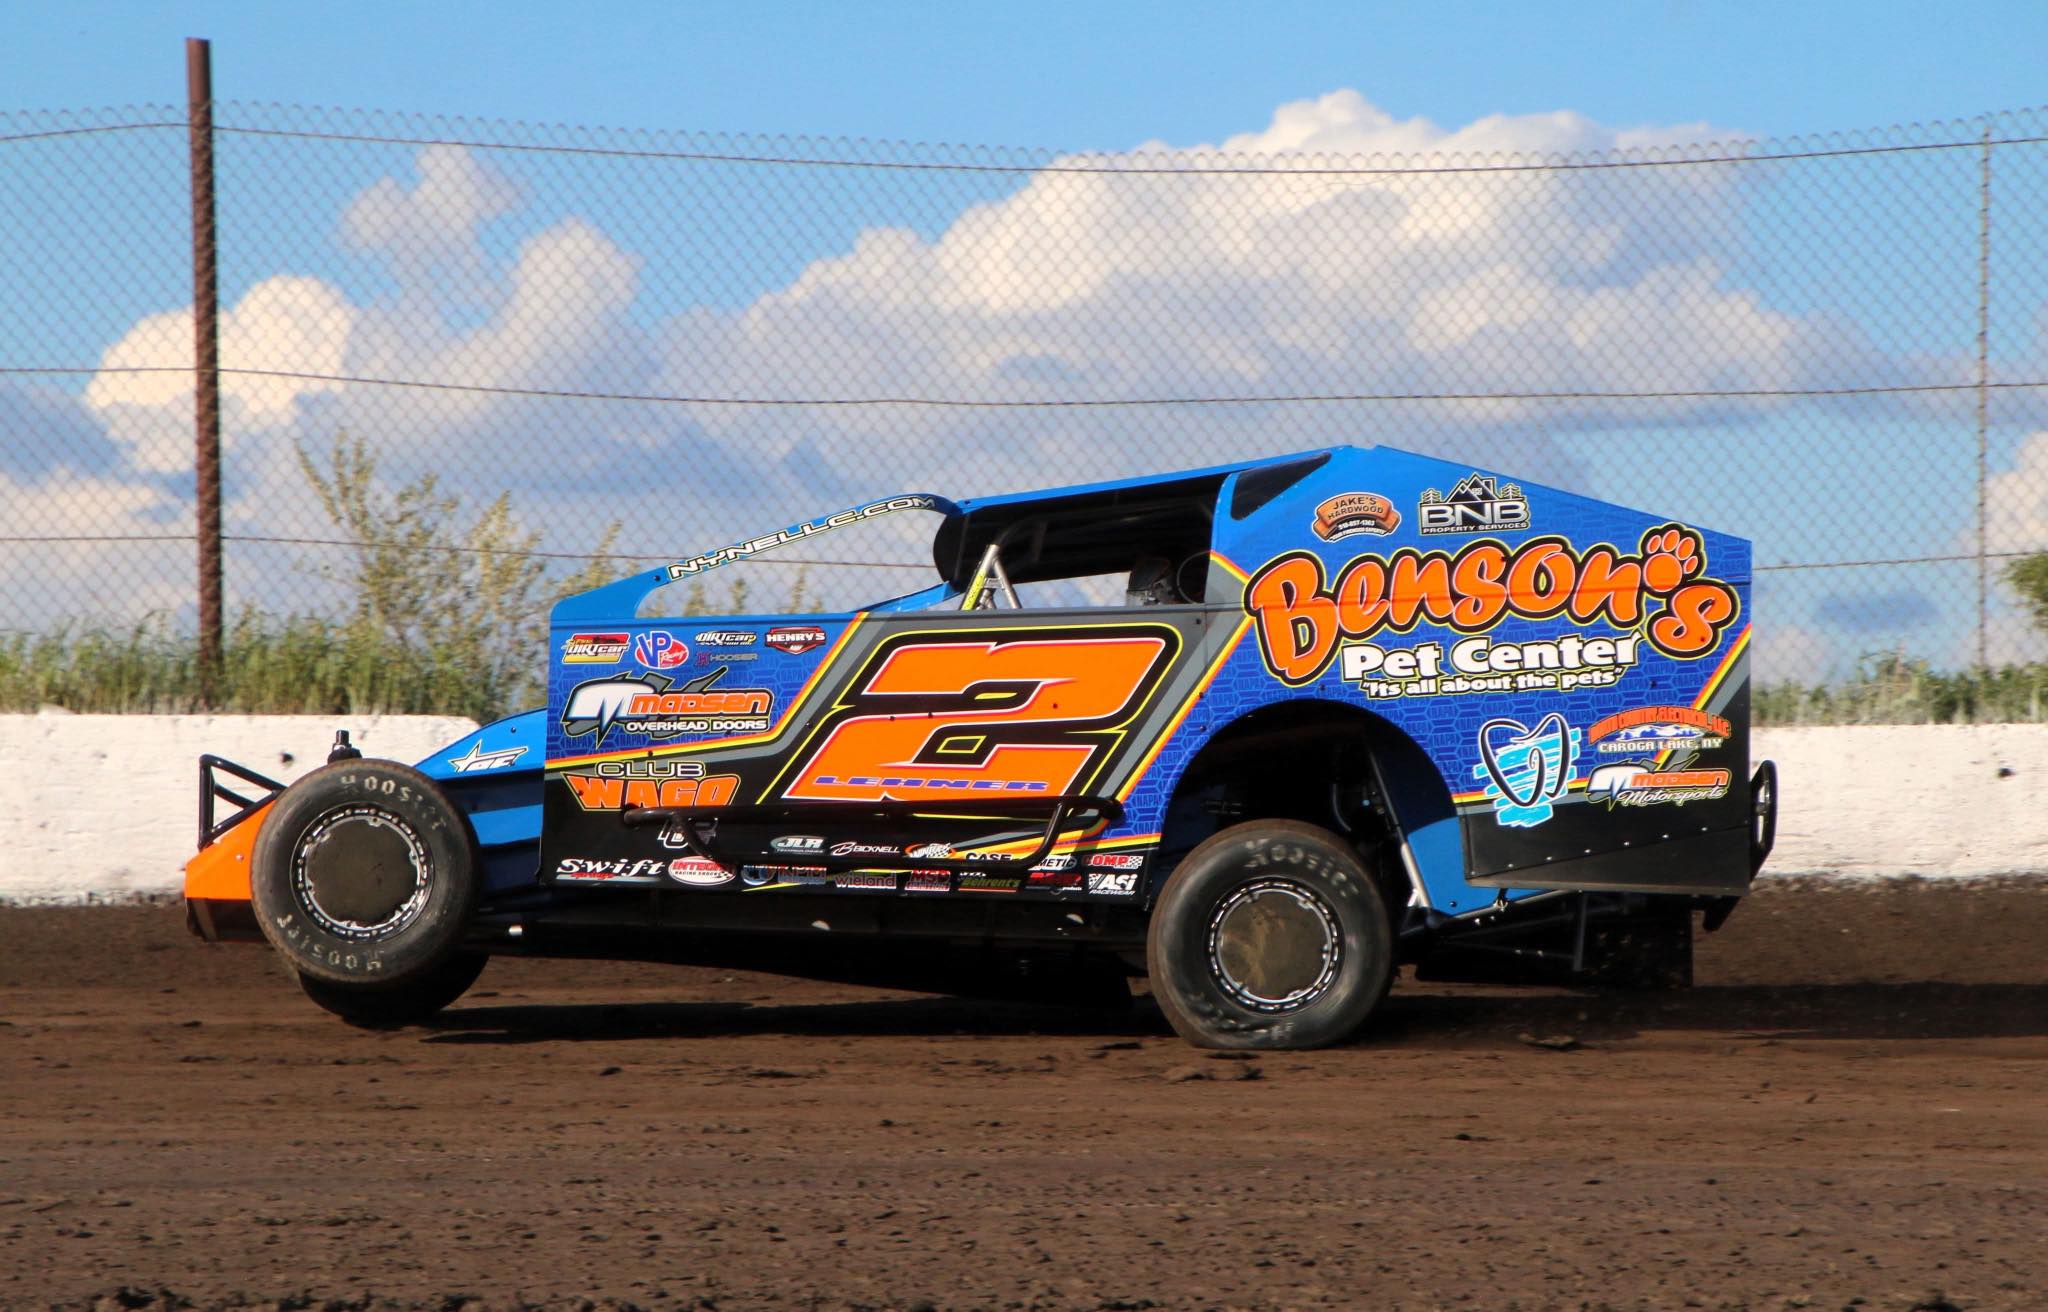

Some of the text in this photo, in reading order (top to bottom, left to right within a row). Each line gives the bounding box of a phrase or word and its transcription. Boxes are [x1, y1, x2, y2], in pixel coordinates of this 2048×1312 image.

[1333, 497, 1376, 509] JAKE'S
[1328, 506, 1383, 519] HARDWOOD
[1421, 501, 1528, 528] BNB
[1423, 522, 1527, 533] PROPERTY SERVICES
[636, 631, 672, 668] VP
[1343, 631, 1642, 681] Pet Center
[1405, 679, 1437, 694] all
[1443, 673, 1512, 693] about
[1516, 670, 1557, 688] the
[626, 719, 767, 732] OVERHEAD DOORS
[782, 638, 1166, 800] 2
[1599, 741, 1655, 754] CAROGA
[1702, 738, 1722, 748] NY
[597, 762, 704, 777] CLUB
[566, 778, 734, 807] WAGO
[1617, 786, 1724, 802] Motorsports
[853, 845, 899, 853] BICKNELL
